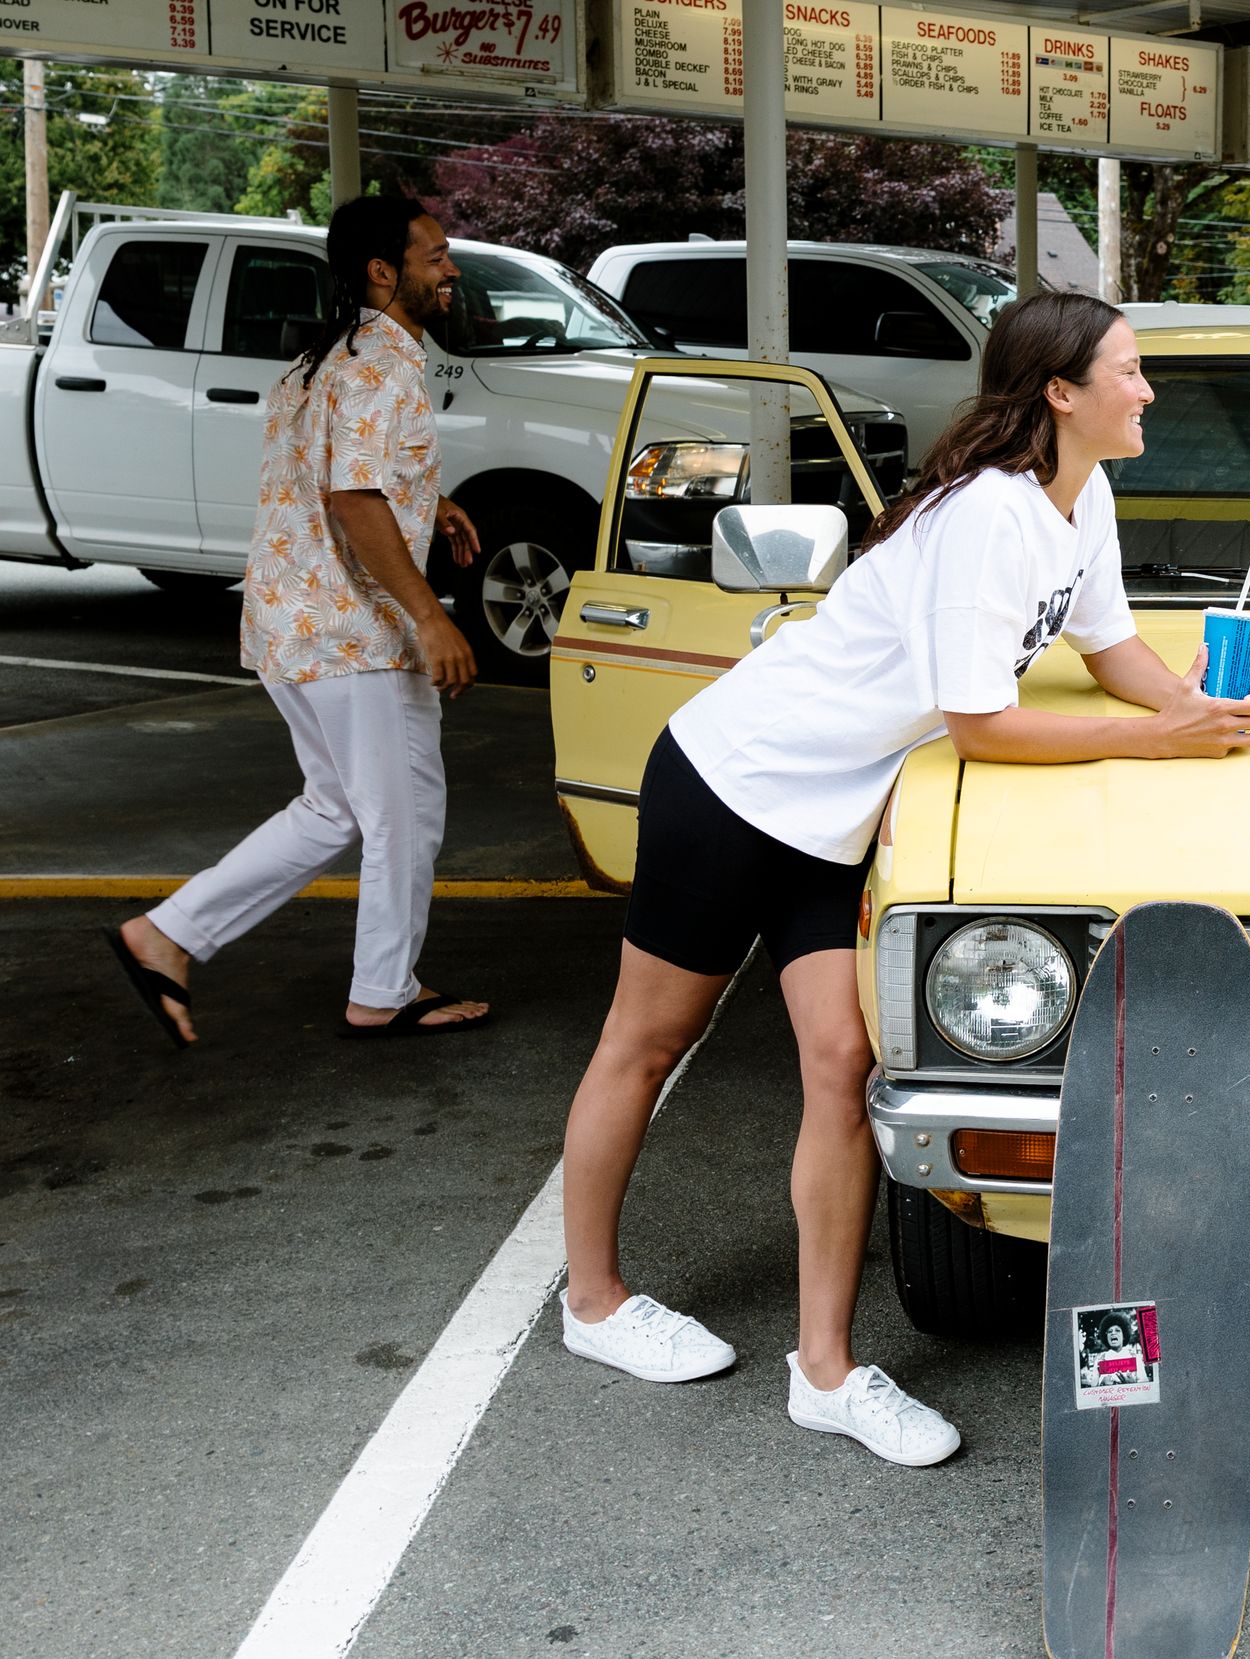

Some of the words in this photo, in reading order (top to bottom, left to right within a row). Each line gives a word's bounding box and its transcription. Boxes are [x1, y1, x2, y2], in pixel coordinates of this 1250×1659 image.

[169, 3, 194, 15] 9.39
[634, 8, 660, 19] PLAIN
[785, 4, 851, 28] SNACKS
[0, 18, 40, 32] OVER
[170, 26, 195, 37] 7.19
[169, 15, 195, 26] 6.59
[399, 1, 501, 47] Burger
[634, 18, 669, 30] DELUXE
[723, 27, 742, 37] 7.99
[249, 17, 347, 45] SERVICE
[634, 28, 671, 40] CHEESE
[723, 37, 742, 47] 8.19
[917, 21, 997, 47] SEAFOODS
[171, 38, 196, 49] 3.39
[479, 41, 497, 53] NO
[634, 38, 687, 52] MUSHROOM
[723, 47, 742, 57] 8.19
[787, 37, 808, 48] LONG
[811, 40, 825, 49] HOT
[829, 42, 845, 52] DOG
[856, 44, 873, 53] 8.59
[891, 40, 928, 53] SEAFOOD
[931, 45, 964, 57] PLATTER
[1044, 39, 1095, 59] DRINKS
[461, 52, 551, 72] SUBSTITUTES
[635, 48, 669, 59] COMBO
[723, 57, 743, 67] 8.19
[801, 48, 834, 60] CHEESE
[856, 53, 873, 61] 6.39
[891, 50, 909, 60] FISH
[912, 52, 917, 60] &
[920, 53, 944, 64] CHIPS
[1138, 51, 1190, 73] SHAKES
[635, 58, 671, 70] DOUBLE
[724, 67, 743, 77] 8.69
[792, 56, 816, 67] CHEESE
[817, 59, 823, 68] &
[825, 60, 846, 71] BACON
[856, 62, 873, 71] 6.89
[891, 59, 924, 70] PRAWNS
[927, 63, 932, 71] &
[935, 64, 958, 75] CHIPS
[635, 67, 666, 79] BACON
[724, 76, 743, 86] 8.19
[792, 75, 813, 85] WITH
[816, 77, 843, 89] GRAVY
[856, 80, 874, 90] 5.49
[856, 71, 874, 80] 4.89
[891, 68, 932, 81] SCALLOPS
[935, 73, 940, 81] &
[943, 73, 966, 85] CHIPS
[1118, 69, 1162, 83] STRAWBERRY
[635, 77, 641, 87] J
[643, 78, 650, 87] &
[653, 79, 659, 88] L
[662, 80, 699, 92] SPECIAL
[724, 87, 743, 96] 9.89
[794, 85, 819, 96] RINGS
[856, 89, 874, 99] 5.49
[899, 77, 926, 88] ORDER
[928, 81, 945, 91] FISH
[948, 83, 954, 92] &
[957, 84, 980, 95] CHIPS
[1118, 78, 1157, 90] CHOCOLATE
[1118, 87, 1145, 97] VANILLA
[1039, 86, 1050, 94] HOT
[1052, 87, 1083, 98] CHOCOLATE
[1090, 92, 1107, 101] 1.70
[1039, 95, 1054, 103] MILK
[1089, 101, 1107, 110] 2.20
[1039, 103, 1052, 112] TEA
[1090, 111, 1107, 120] 1.70
[1039, 111, 1063, 122] COFFEE
[1139, 101, 1187, 121] FLOATS
[1039, 123, 1053, 132] ICE
[1057, 124, 1072, 134] TEA
[434, 364, 464, 379] 249
